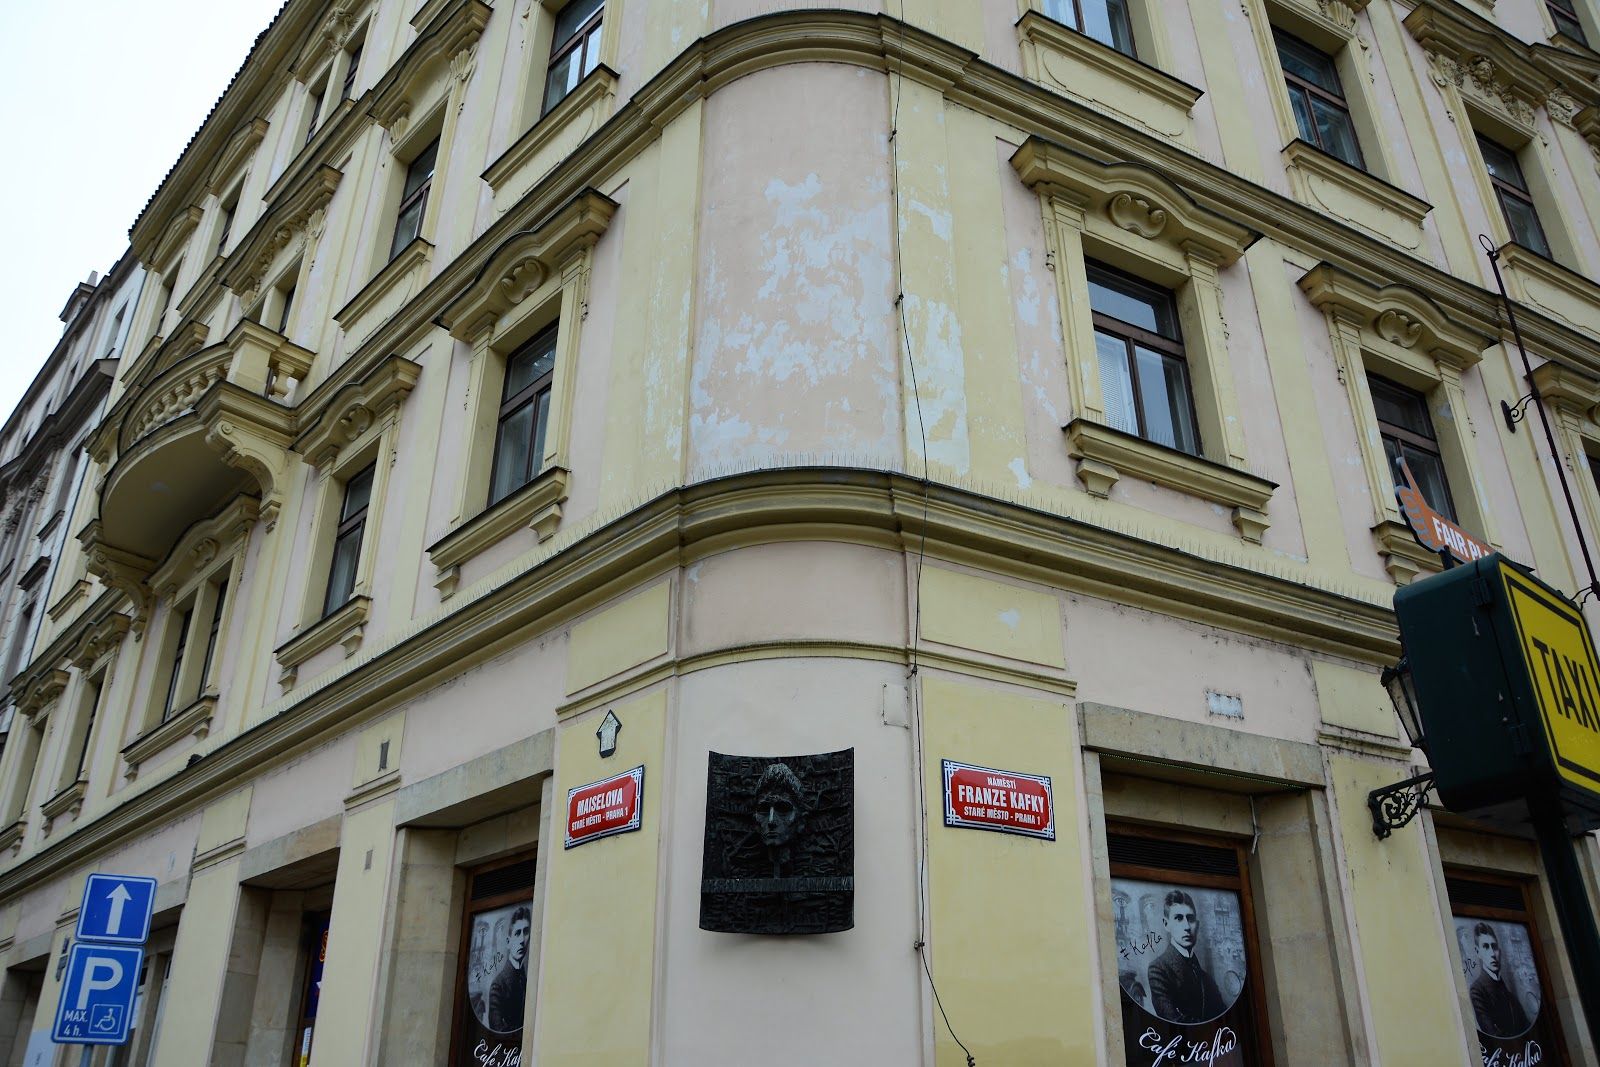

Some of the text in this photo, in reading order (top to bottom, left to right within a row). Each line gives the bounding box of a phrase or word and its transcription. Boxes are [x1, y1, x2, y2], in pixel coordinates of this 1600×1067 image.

[1432, 516, 1469, 559] FAIR
[1531, 636, 1600, 733] TAXI
[987, 776, 1017, 789] NÁMĚSTÍ
[577, 787, 623, 817] MAISELOVA
[958, 785, 1044, 813] FRANZE KAFKY
[571, 817, 586, 831] STARÉ
[586, 813, 602, 827] MĚSTO
[605, 809, 624, 821] PRAHA
[624, 807, 629, 816] 1
[964, 806, 986, 818] STARÉ
[987, 808, 1009, 820] MĚSTO
[1015, 813, 1036, 825] PRAHA
[1037, 816, 1041, 825] 1
[76, 956, 124, 1009] P
[63, 1024, 82, 1036] 4 h.
[64, 1010, 88, 1023] MAX.
[1138, 1026, 1237, 1067] Café Kafka
